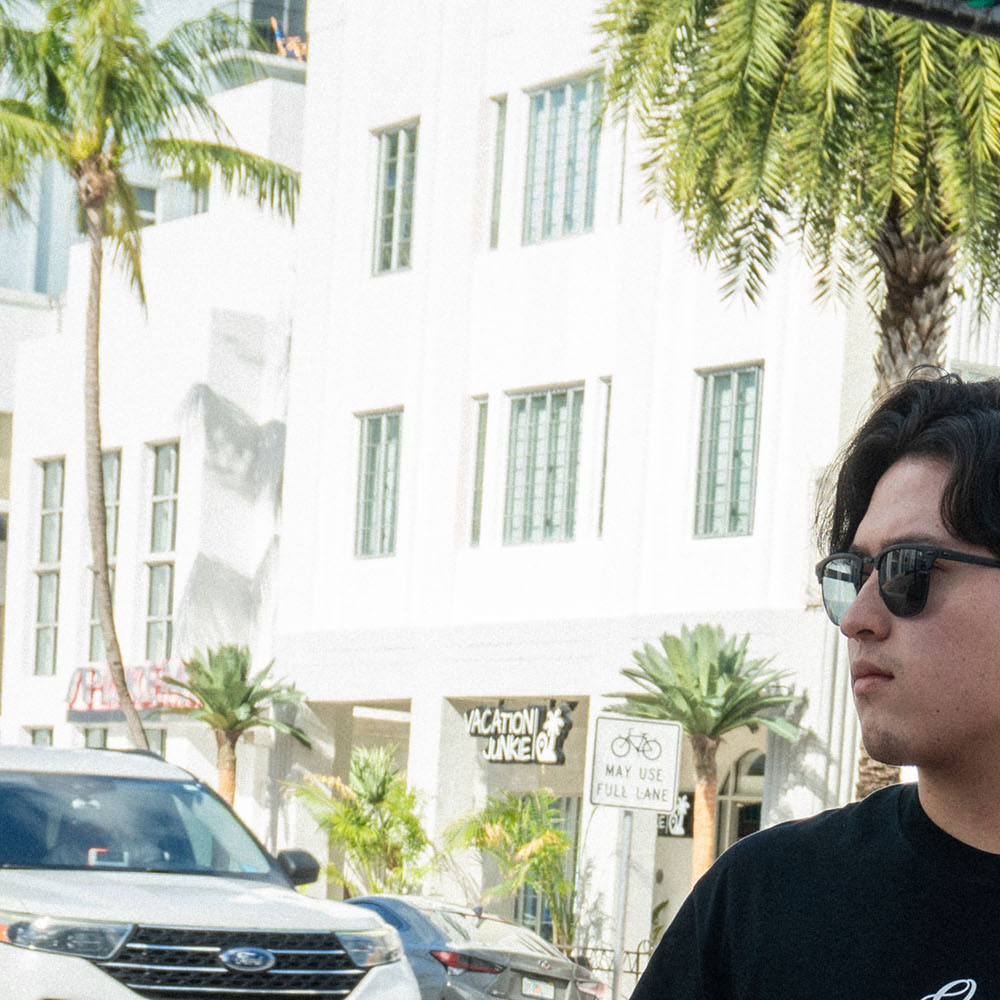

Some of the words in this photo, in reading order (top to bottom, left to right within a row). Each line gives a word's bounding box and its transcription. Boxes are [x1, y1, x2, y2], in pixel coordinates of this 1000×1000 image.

[463, 707, 535, 735] VACATION
[605, 763, 632, 778] MAY
[639, 766, 663, 782] USE
[596, 782, 627, 798] FULL
[636, 786, 668, 802] LANE
